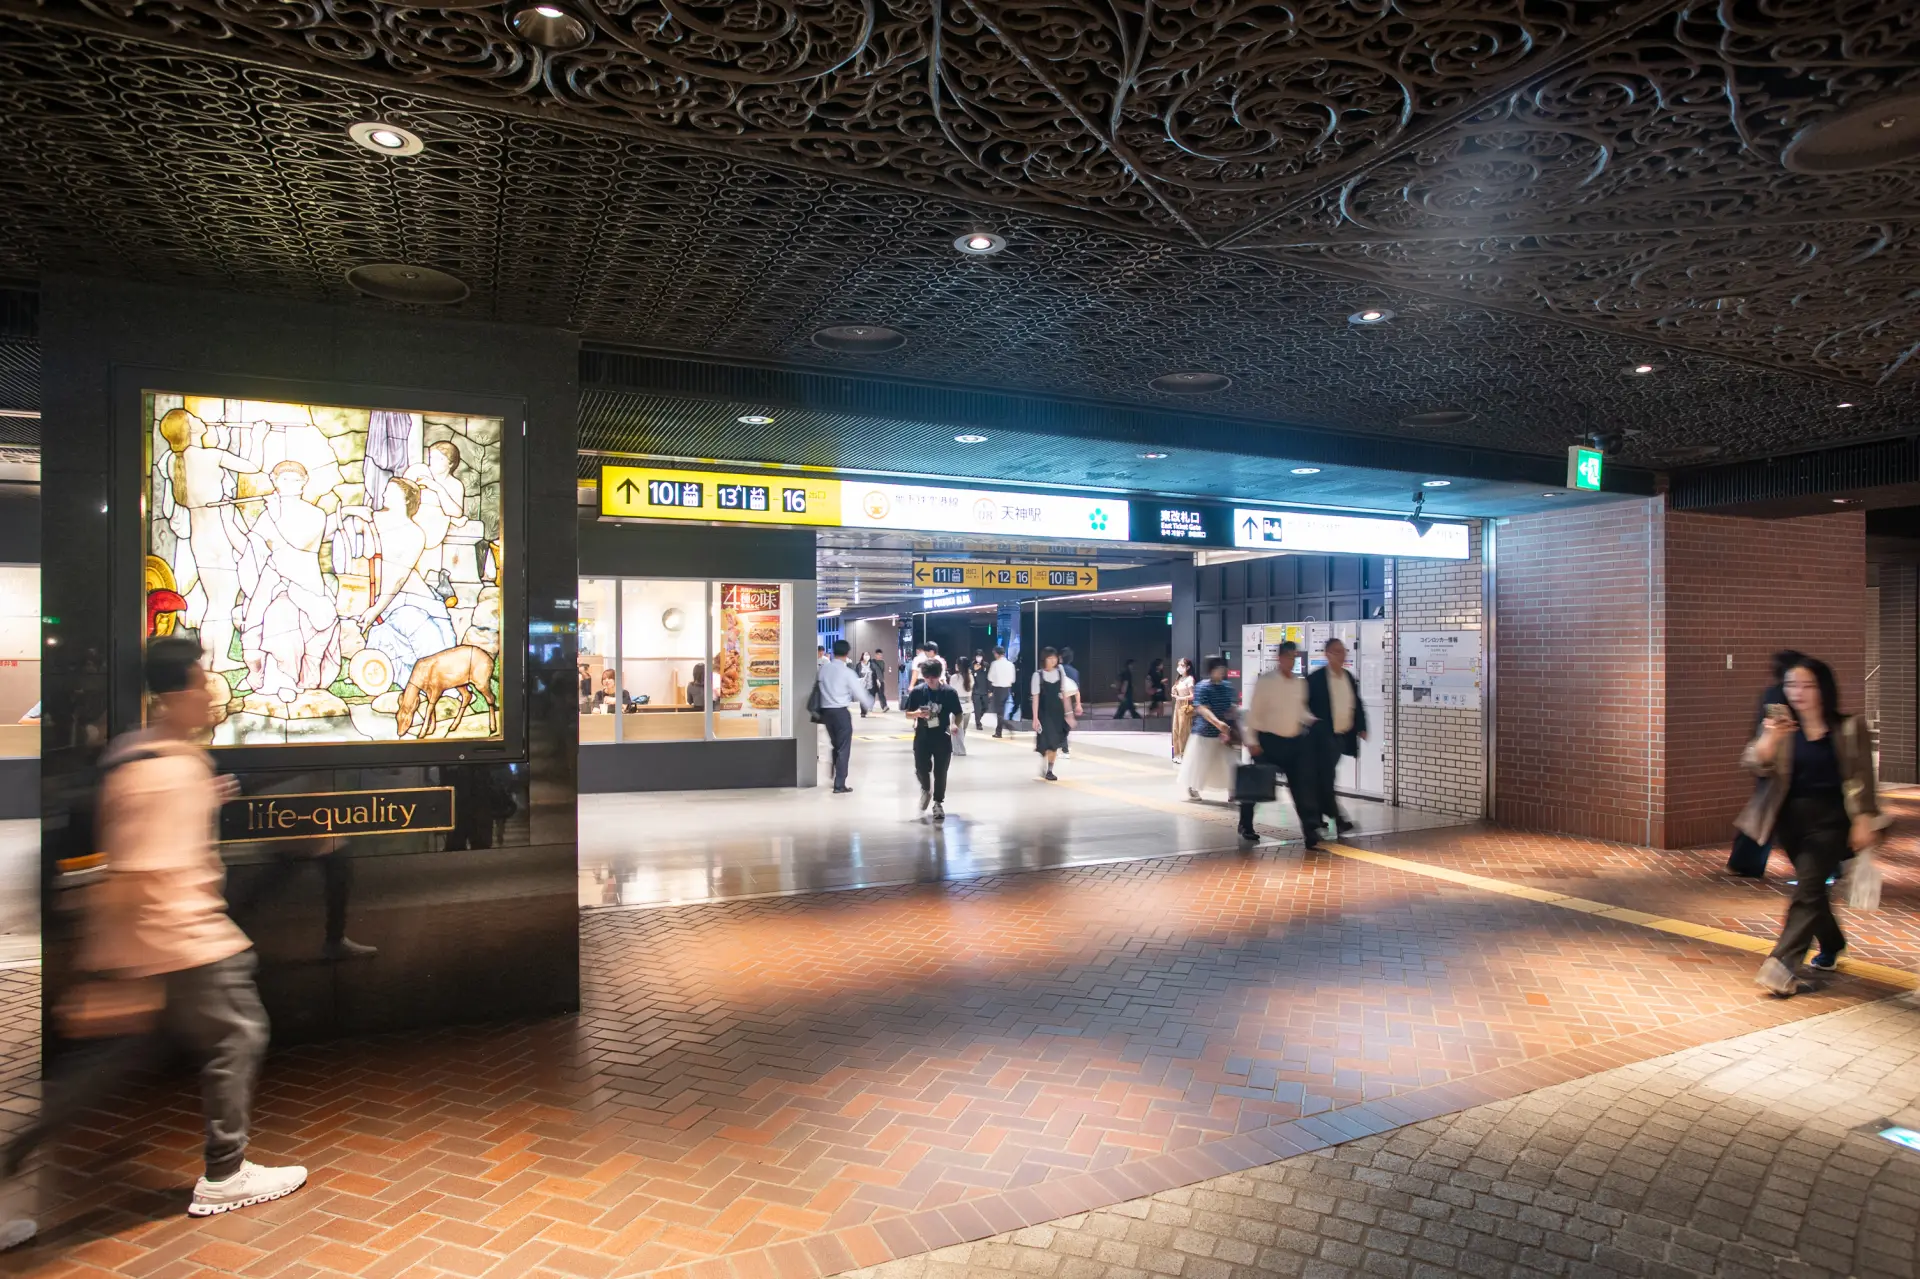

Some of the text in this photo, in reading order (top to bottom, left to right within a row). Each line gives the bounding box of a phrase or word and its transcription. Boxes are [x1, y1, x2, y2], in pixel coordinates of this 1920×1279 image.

[648, 481, 674, 505] 10
[782, 489, 806, 512] 16
[1001, 505, 1042, 522] 天神駅
[1160, 510, 1200, 523] 東改札口
[934, 568, 947, 582] 11
[999, 571, 1010, 582] 12
[1017, 572, 1028, 584] 16
[1049, 571, 1062, 584] 10
[248, 796, 417, 831] life-quality
